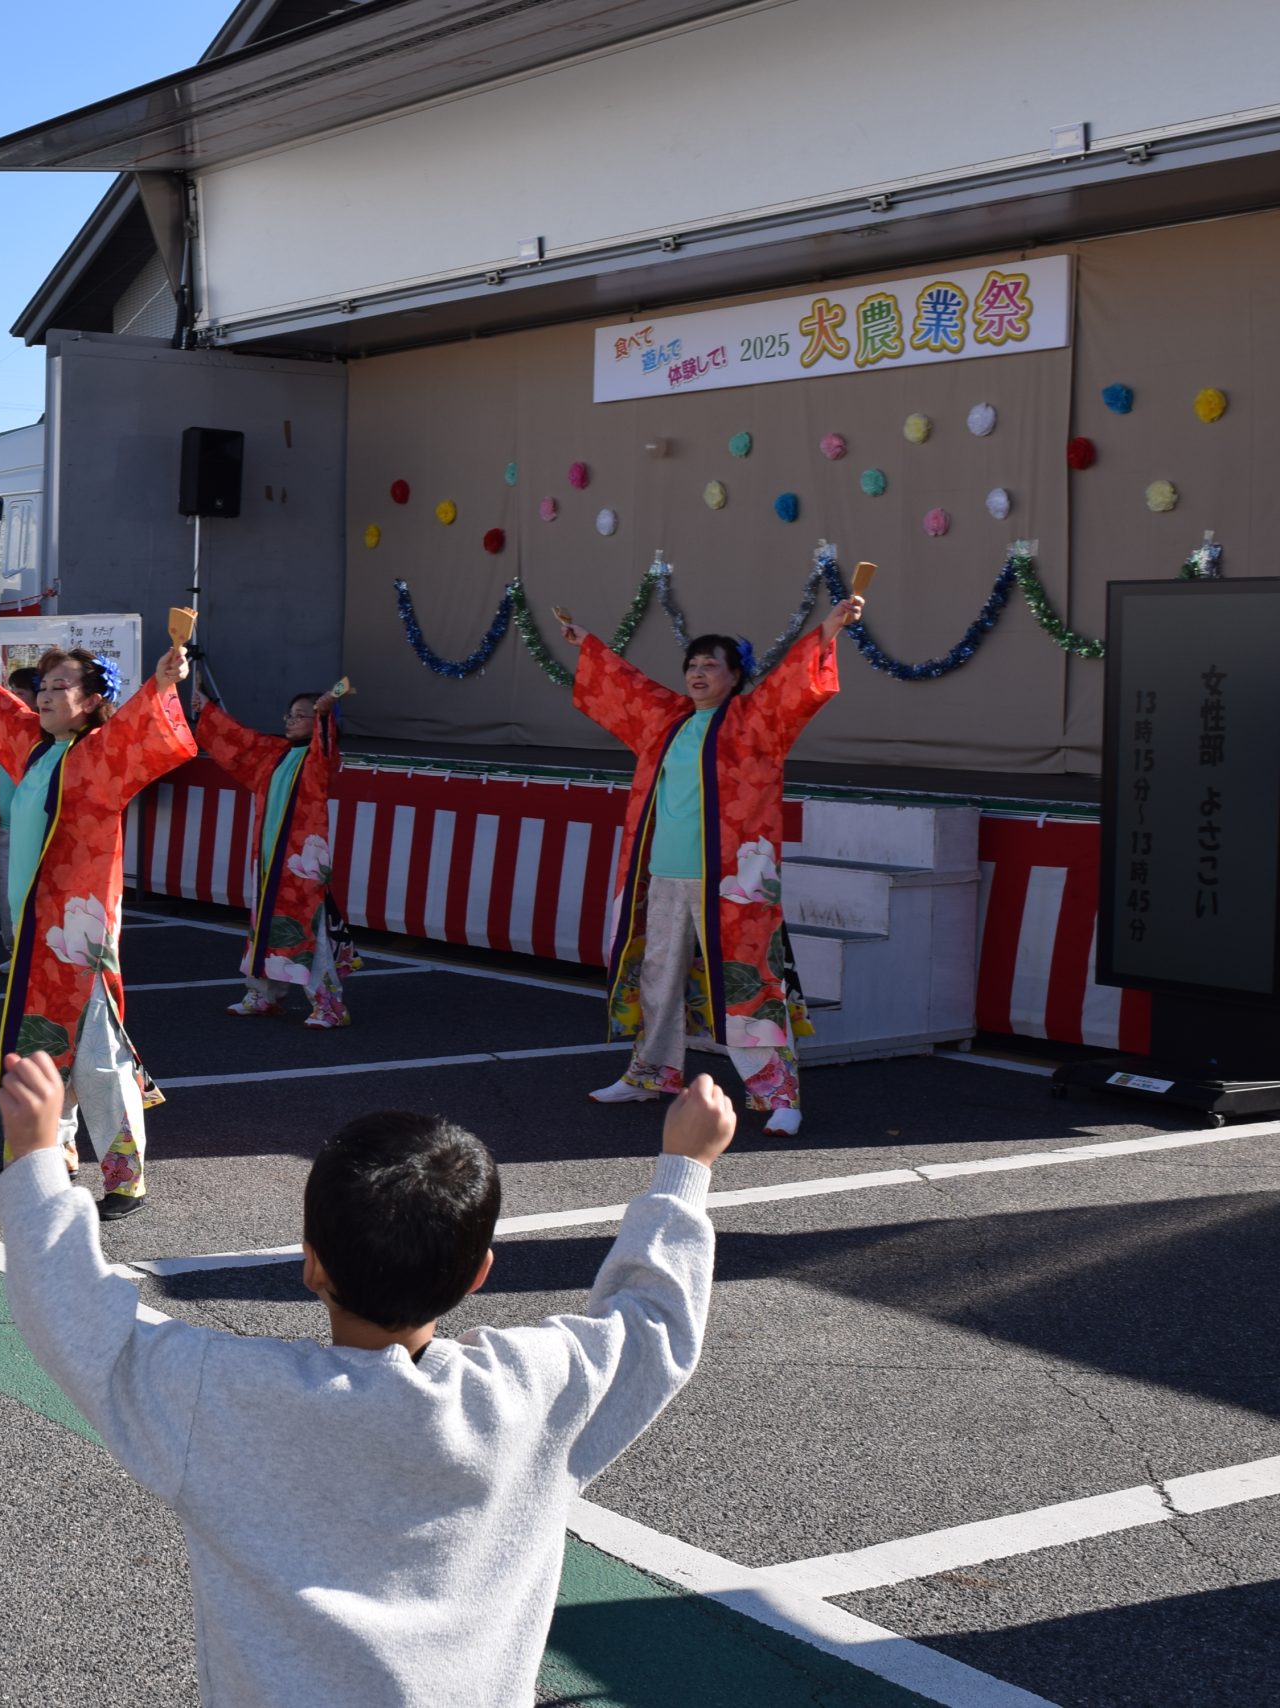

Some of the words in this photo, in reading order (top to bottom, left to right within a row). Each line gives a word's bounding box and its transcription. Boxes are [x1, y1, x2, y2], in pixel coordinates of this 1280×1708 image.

[614, 325, 653, 360] 食べて
[641, 338, 682, 372] 遊んで
[740, 332, 790, 362] 2025
[799, 270, 1032, 368] 大農業祭
[1200, 665, 1227, 767] 女性部
[1195, 786, 1223, 918] よさこい
